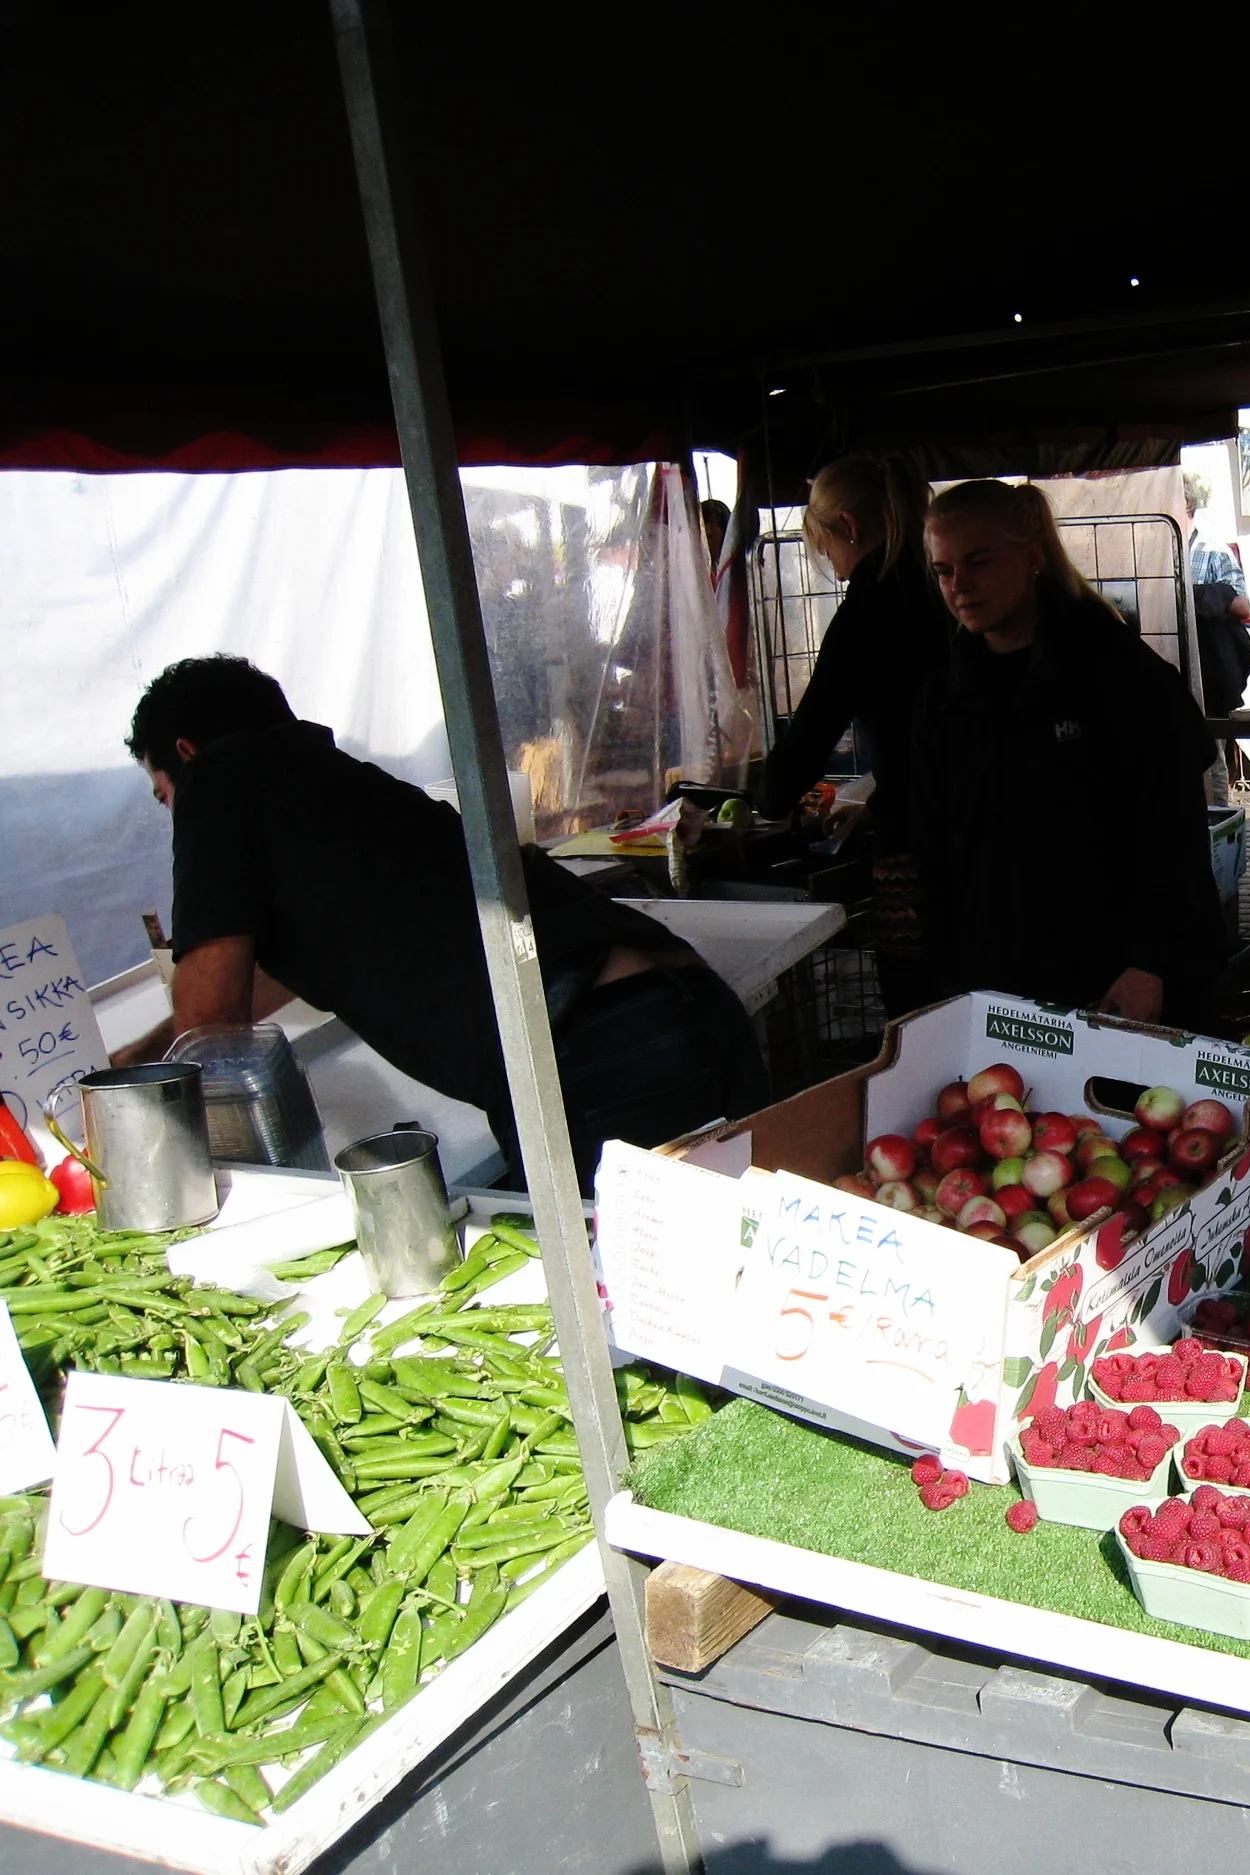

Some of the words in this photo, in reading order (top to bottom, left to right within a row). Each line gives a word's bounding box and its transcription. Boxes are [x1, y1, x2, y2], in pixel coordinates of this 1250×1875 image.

[987, 1005, 1073, 1031] HEDELMÄTARHA
[988, 1019, 1073, 1051] AXELSSON
[1001, 1040, 1058, 1060] ANGELNIEMI
[778, 1195, 904, 1264] MAKEA
[767, 1236, 936, 1317] VADELMA
[60, 1403, 127, 1536] 3
[182, 1426, 256, 1563] 5
